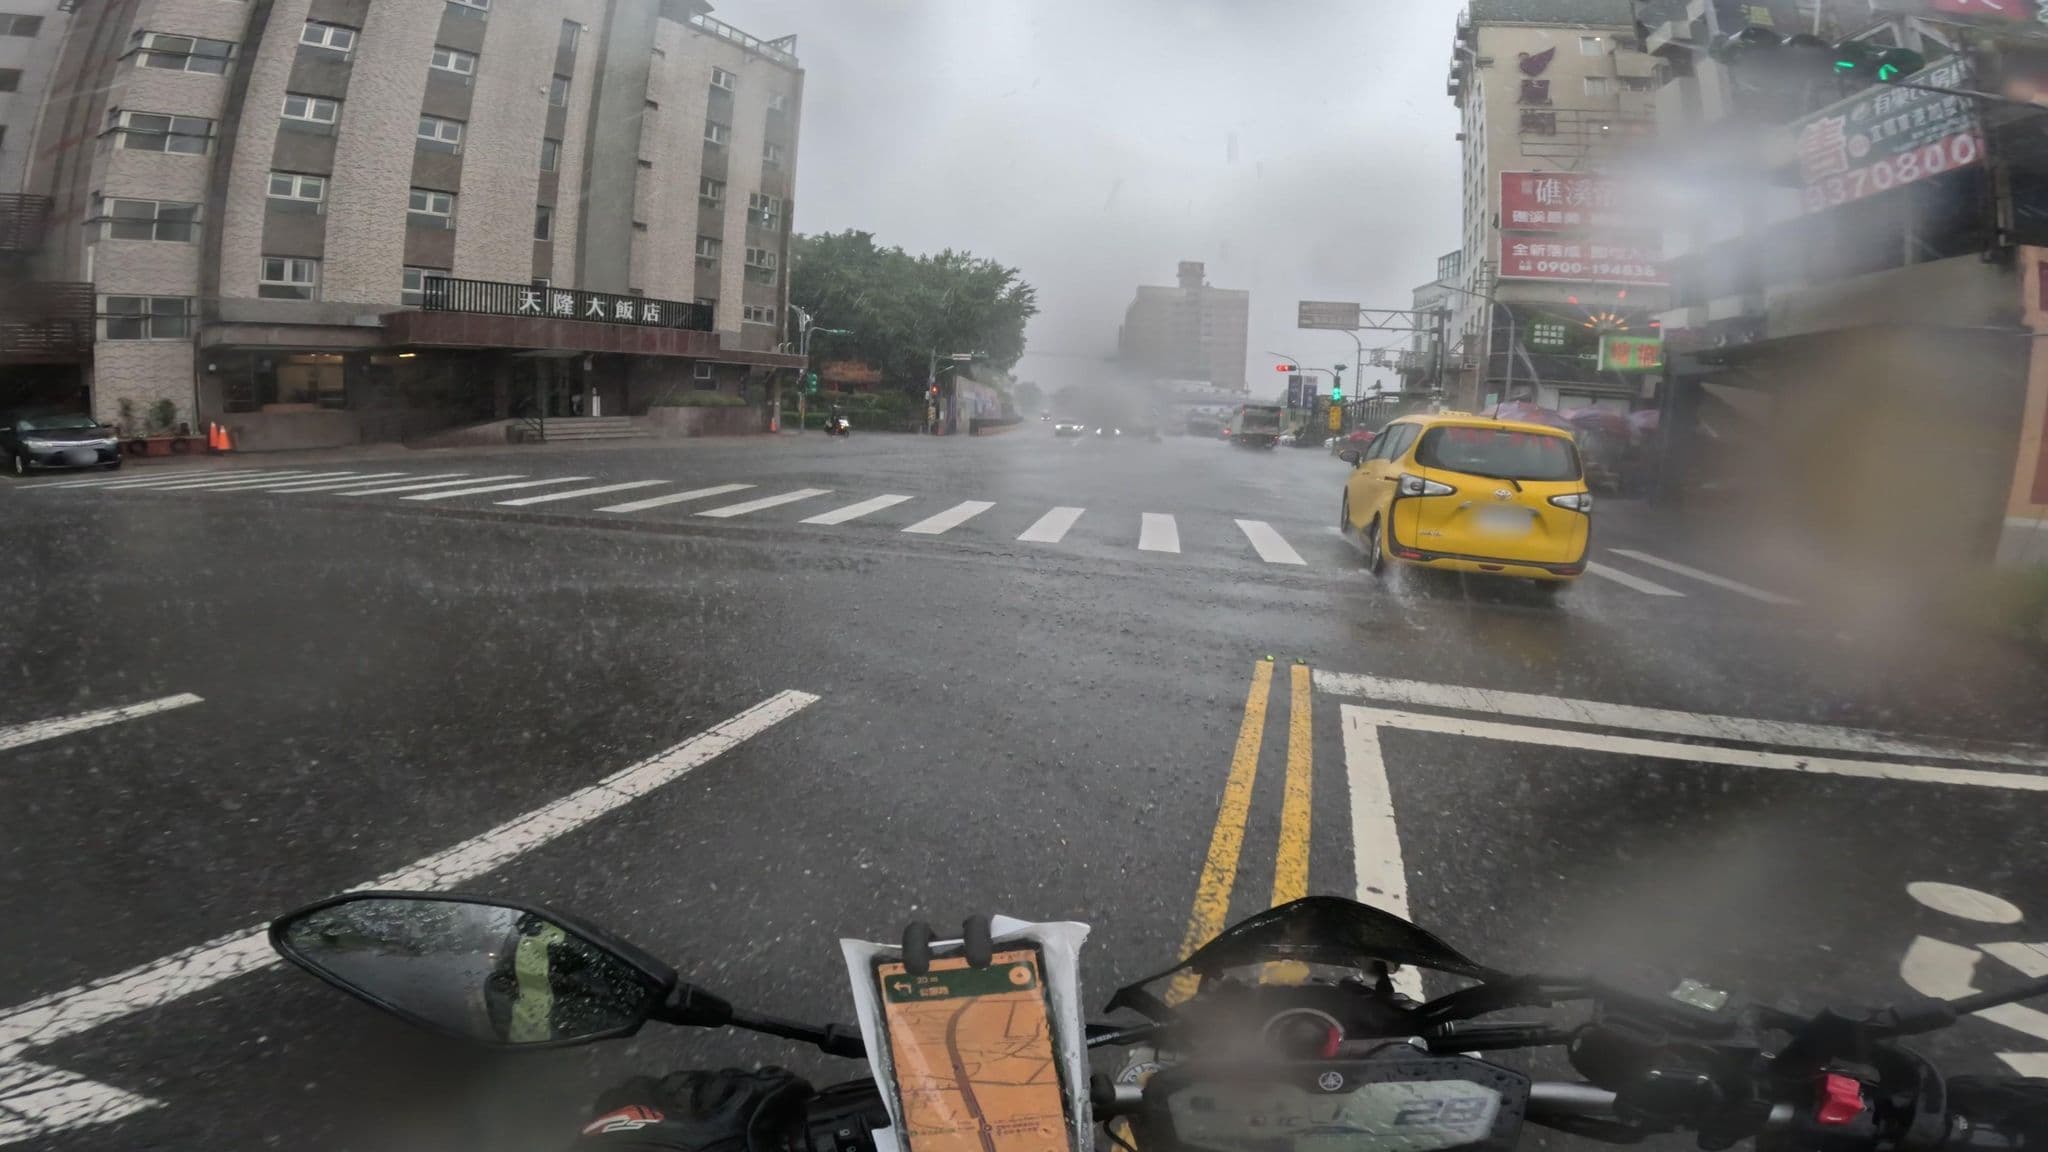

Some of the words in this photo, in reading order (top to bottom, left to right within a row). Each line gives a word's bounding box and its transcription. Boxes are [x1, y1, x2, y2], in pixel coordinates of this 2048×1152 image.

[519, 289, 661, 322] 天隆大飯店
